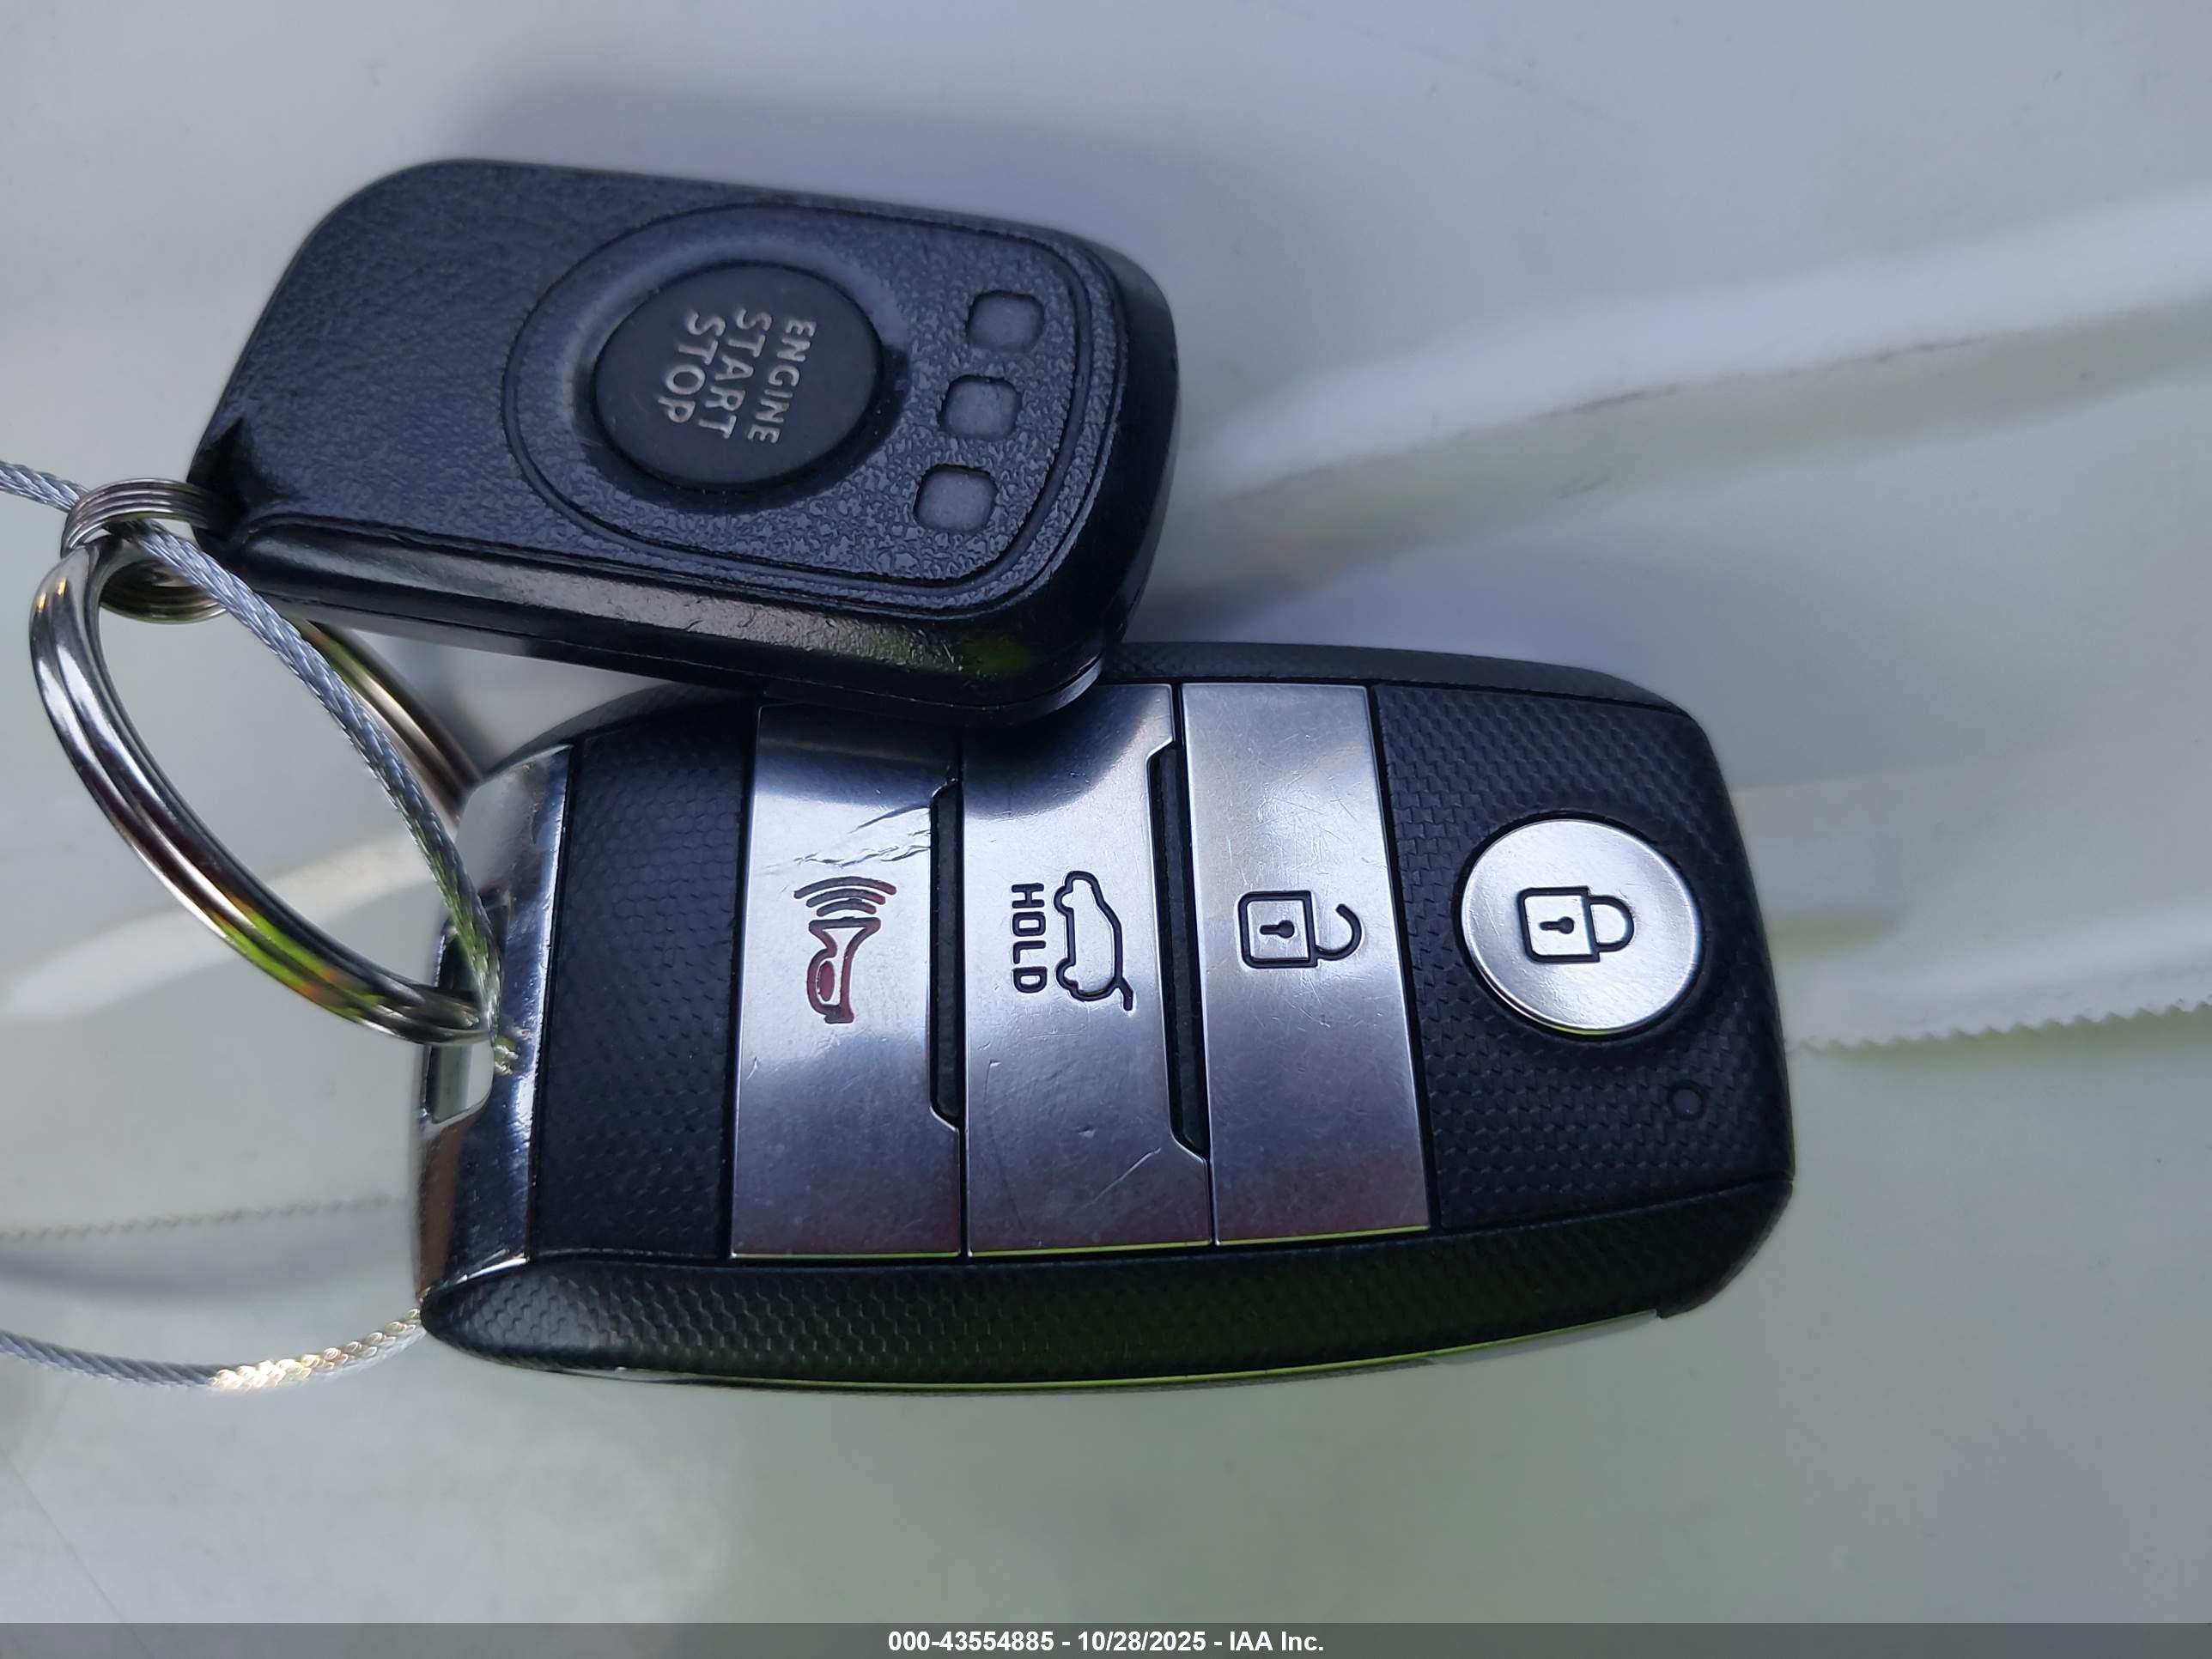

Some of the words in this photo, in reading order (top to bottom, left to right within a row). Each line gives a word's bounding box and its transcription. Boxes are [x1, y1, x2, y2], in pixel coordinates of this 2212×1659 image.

[658, 311, 726, 423] STOP
[698, 308, 772, 439] START
[747, 319, 817, 443] ENGINE
[1011, 882, 1048, 994] HOLD
